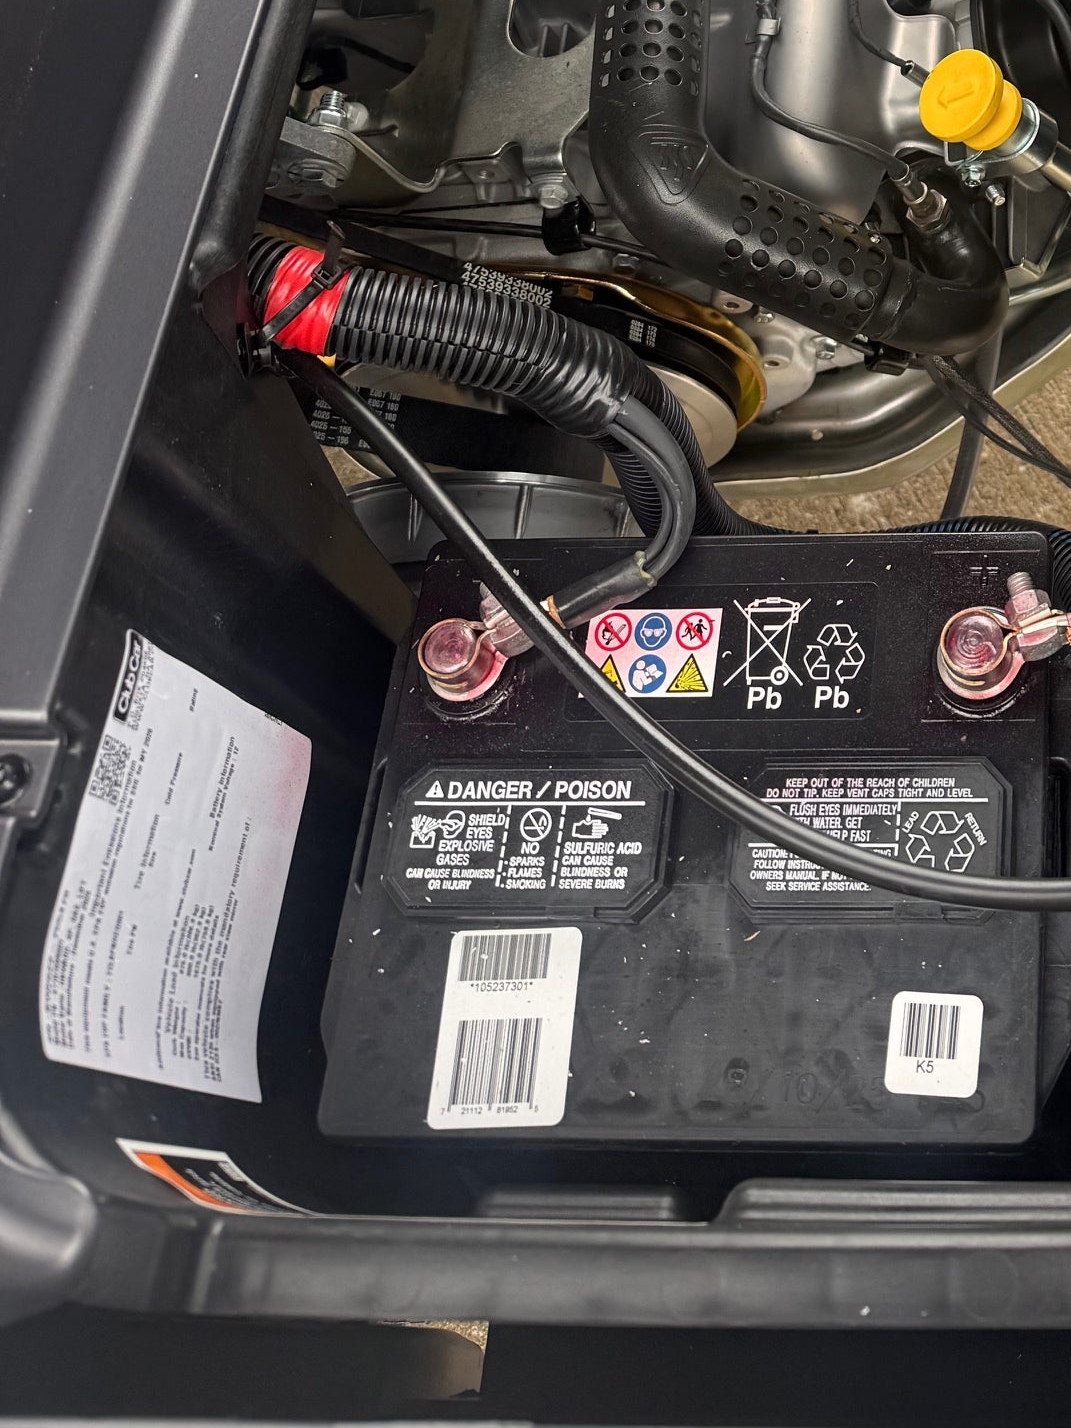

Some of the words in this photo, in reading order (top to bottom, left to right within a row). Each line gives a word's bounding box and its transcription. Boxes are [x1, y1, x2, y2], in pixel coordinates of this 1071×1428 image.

[461, 271, 551, 308] 47539338002
[118, 673, 136, 714] Club
[129, 640, 141, 671] Car
[747, 686, 782, 709] Pb
[814, 686, 850, 709] Pb
[786, 778, 809, 788] KEEP
[810, 778, 829, 788] OUT
[831, 778, 845, 788] OF
[846, 778, 864, 788] THE
[866, 778, 895, 788] REACH
[897, 778, 911, 788] OF
[912, 778, 955, 788] CHILDREN
[447, 780, 533, 799] DANGER
[535, 780, 552, 799] /
[554, 780, 632, 799] POISON
[766, 788, 780, 798] DO
[782, 788, 802, 798] NOT
[803, 788, 820, 798] TIP.
[821, 788, 845, 798] KEEP
[847, 788, 870, 798] VENT
[871, 788, 895, 798] CAPS
[898, 788, 924, 798] TIGHT
[926, 788, 945, 798] AND
[947, 788, 973, 798] LEVEL
[789, 804, 817, 816] FLUSH
[819, 804, 841, 816] EYES
[842, 804, 897, 816] IMMEDIATELY
[468, 813, 505, 826] SHIELD
[902, 810, 920, 833] LEAD
[466, 827, 493, 839] EYES
[963, 812, 987, 847] RETURN
[438, 840, 495, 853] EXPLOSIVE
[520, 842, 539, 855] NO
[563, 841, 615, 855] SULFURIC
[616, 841, 642, 855] ACID
[436, 853, 470, 866] GASES
[509, 856, 545, 867] SPARKS
[562, 855, 582, 866] CAN
[583, 855, 614, 866] CAUSE
[406, 868, 424, 878] CAN
[424, 868, 451, 878] CAUSE
[452, 868, 495, 878] BLINDNESS
[507, 867, 543, 878] FLAMES
[560, 866, 611, 878] BLINDNESS
[614, 866, 628, 878] OR
[428, 879, 441, 890] OR
[442, 879, 472, 890] INJURY
[505, 879, 546, 889] SMOKING
[558, 878, 593, 889] SEVERE
[595, 878, 626, 889] BURNS
[765, 881, 787, 891] SEEK
[788, 881, 821, 891] SERVICE
[822, 881, 872, 891] ASSISTANCE.
[916, 1060, 934, 1073] K5
